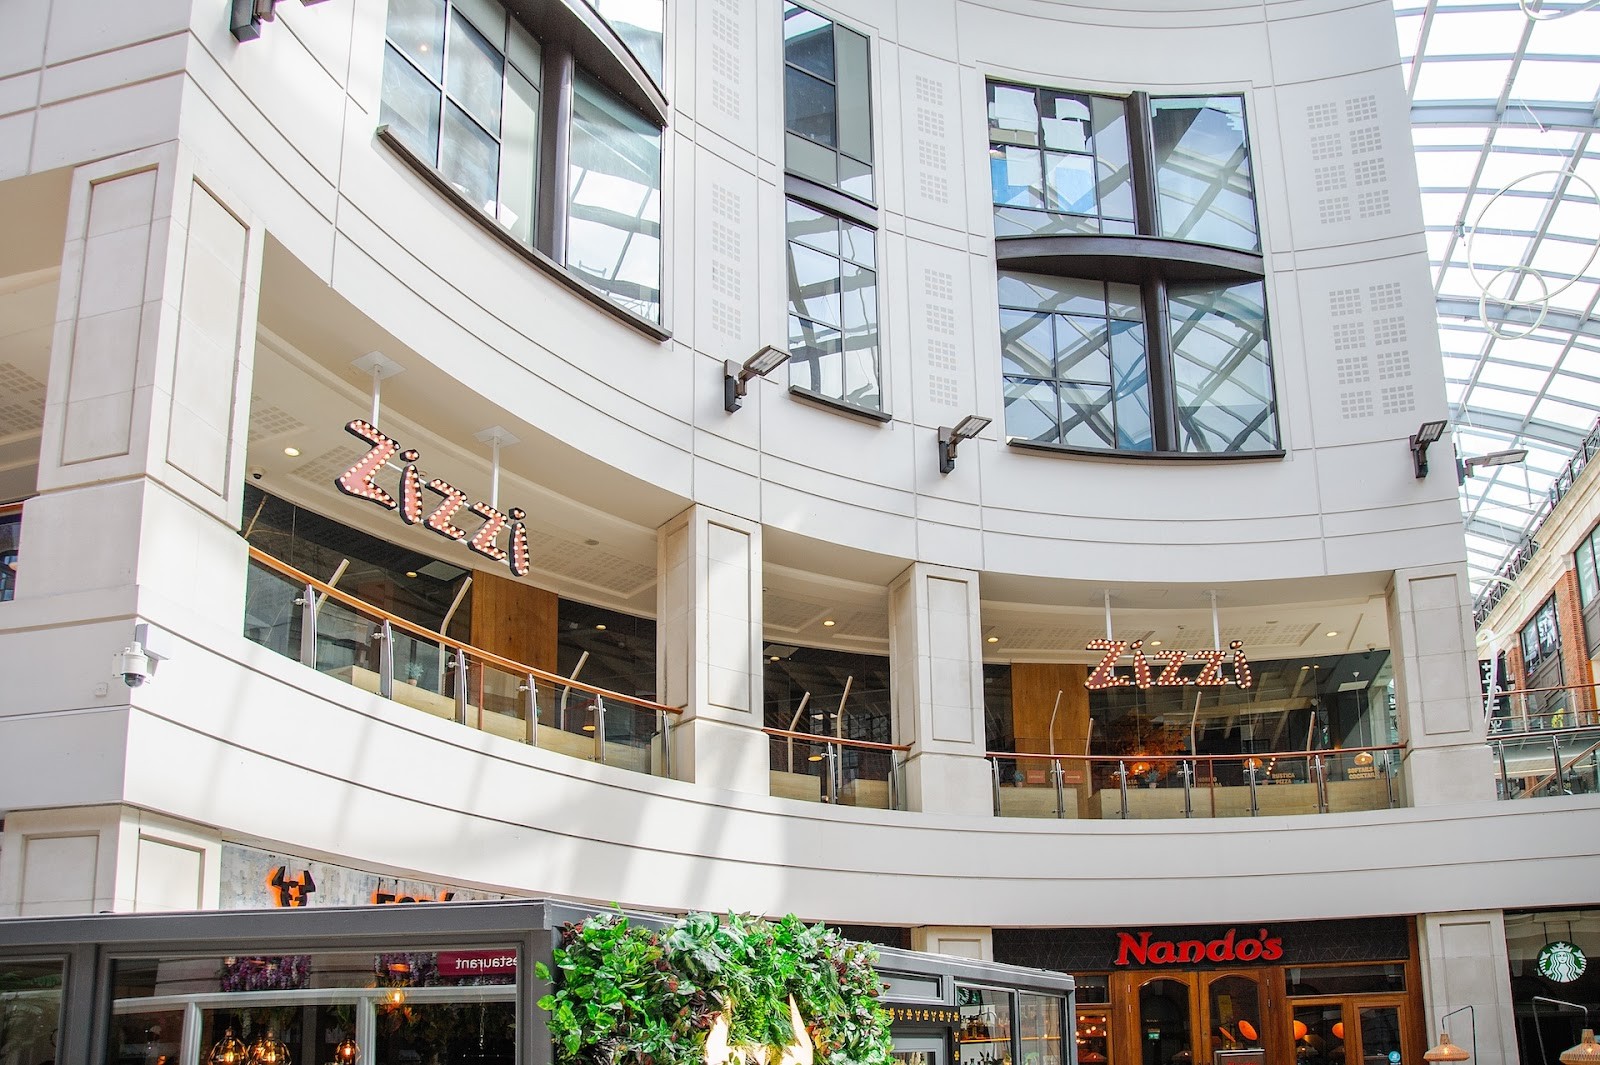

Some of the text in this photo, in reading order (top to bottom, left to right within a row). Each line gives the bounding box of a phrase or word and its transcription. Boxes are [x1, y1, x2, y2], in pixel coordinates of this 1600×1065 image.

[335, 419, 530, 577] Zizzi
[1084, 639, 1252, 689] Zizzi
[1114, 928, 1283, 965] Nando's
